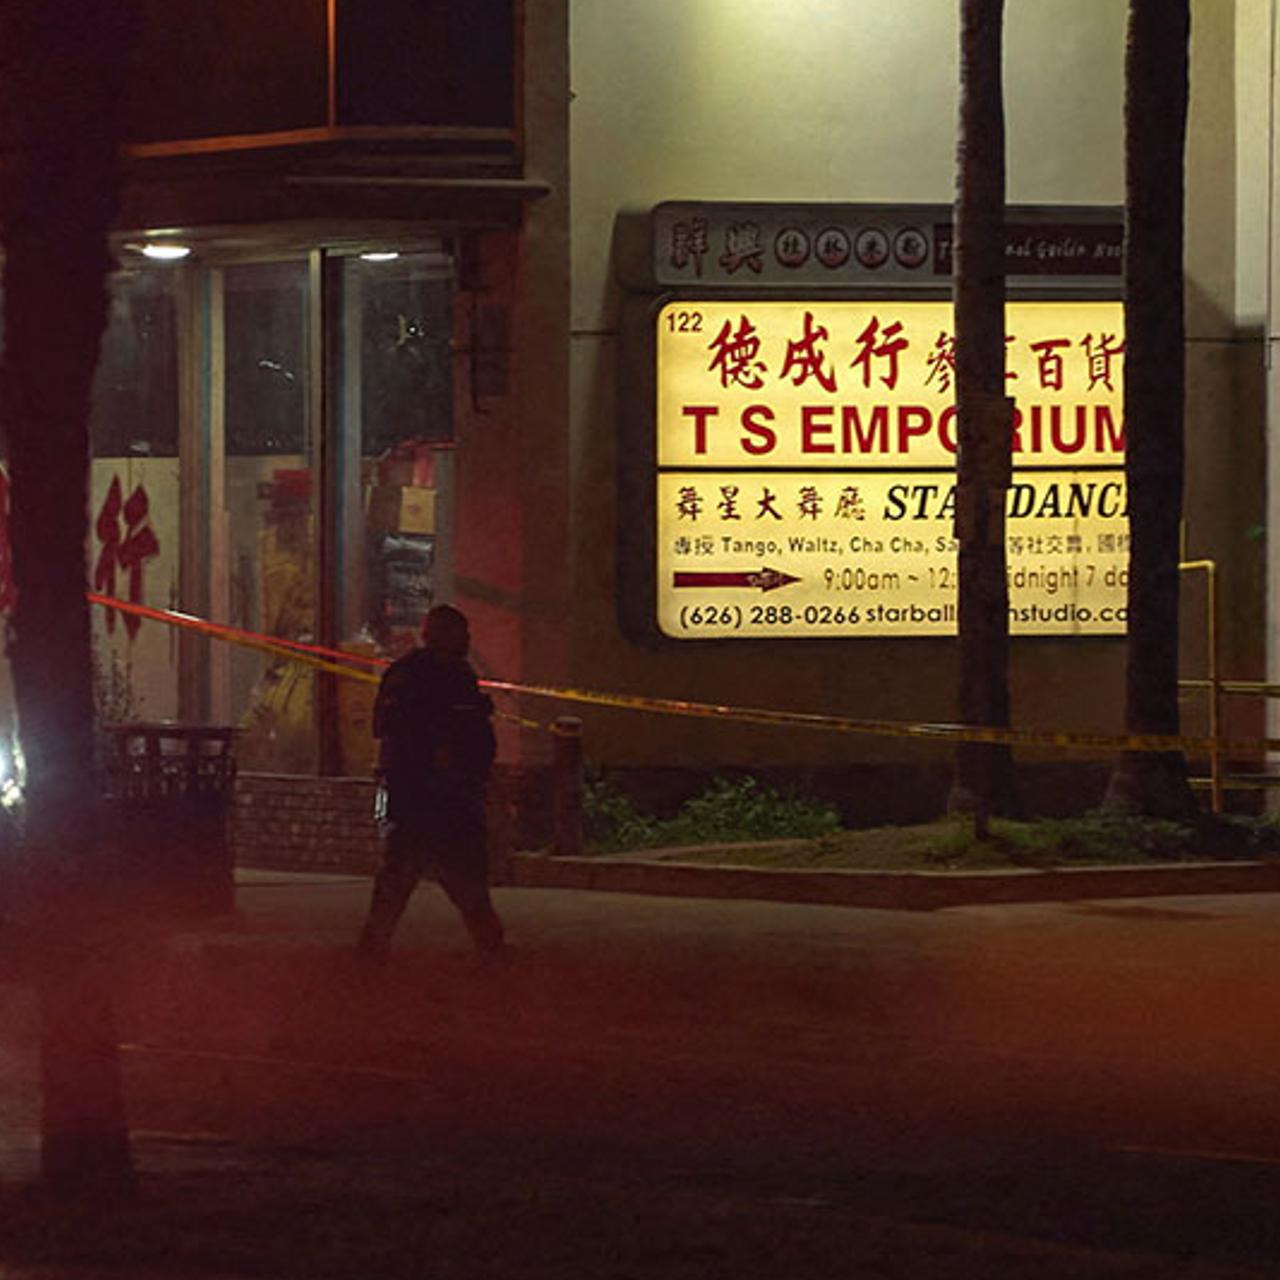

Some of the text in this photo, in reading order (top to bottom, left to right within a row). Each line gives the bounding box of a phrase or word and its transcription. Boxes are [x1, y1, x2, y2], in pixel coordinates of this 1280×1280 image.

[666, 312, 704, 333] 122
[682, 405, 719, 455] T
[740, 404, 778, 456] S
[1008, 482, 1130, 519] DANC
[721, 536, 783, 557] Tango,
[788, 536, 843, 556] Waltz,
[849, 536, 885, 553] Cha
[890, 536, 930, 555] Cha,
[1006, 564, 1078, 595] idnight
[679, 605, 743, 629] (626)
[750, 605, 861, 625] 288-0266
